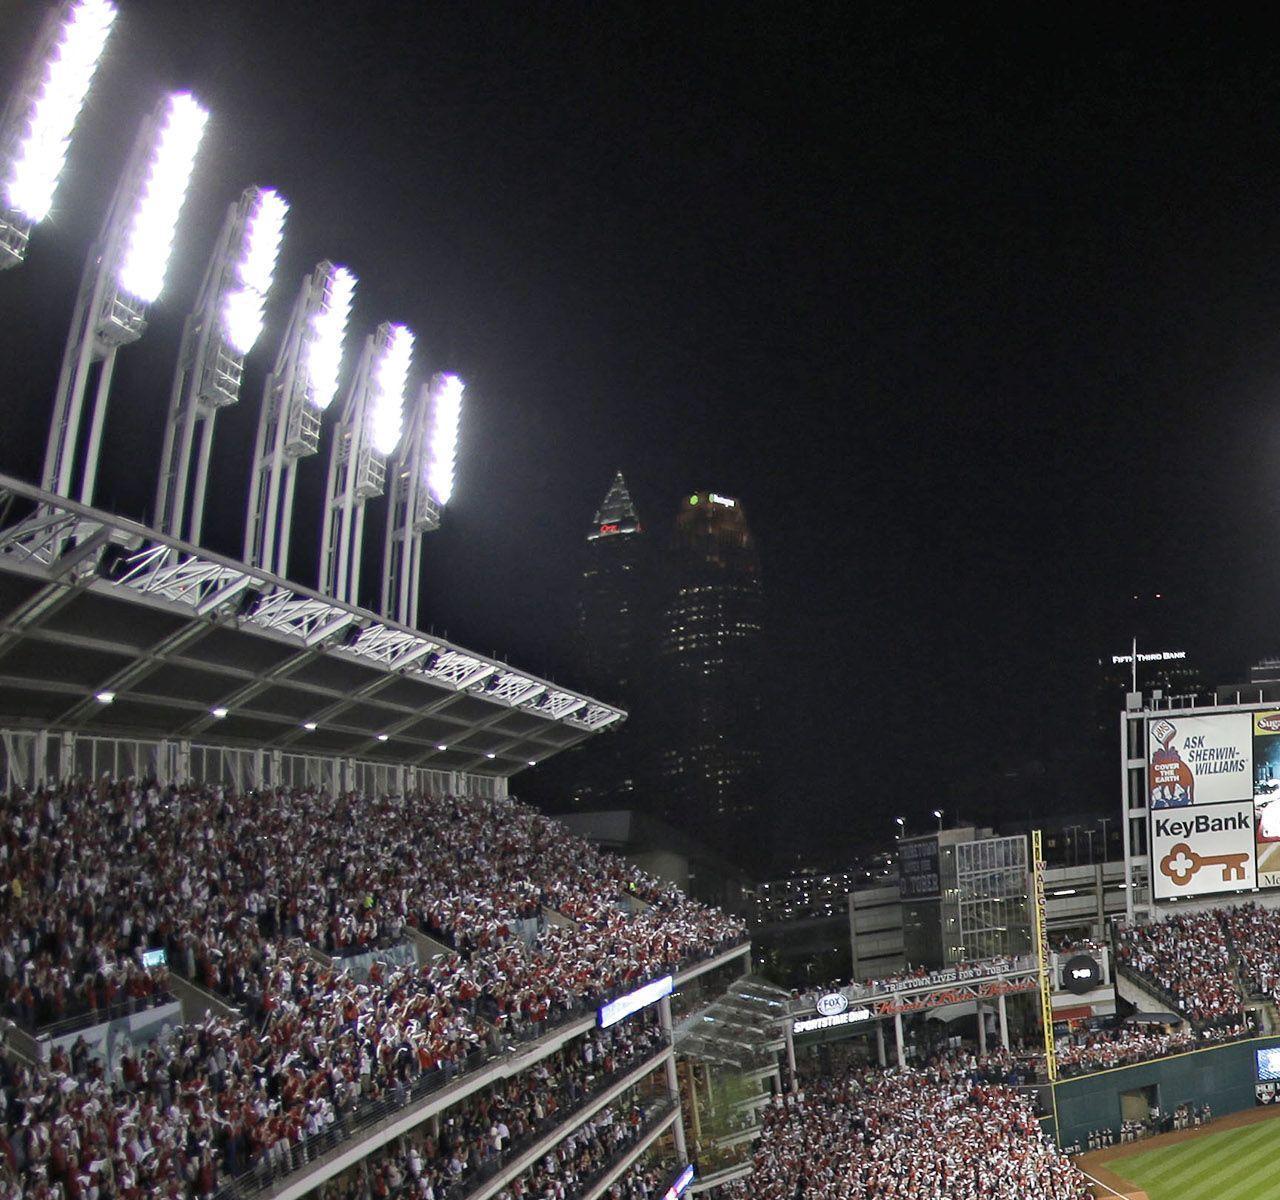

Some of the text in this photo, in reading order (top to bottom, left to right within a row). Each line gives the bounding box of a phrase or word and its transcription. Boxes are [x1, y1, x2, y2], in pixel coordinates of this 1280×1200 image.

[1163, 652, 1186, 660] BANK
[1183, 736, 1205, 750] ASK
[1188, 747, 1240, 763] SHERWIN-
[1154, 763, 1180, 771] COVER
[1195, 759, 1245, 776] WILLIAMS
[1155, 775, 1180, 783] EARTH
[1156, 812, 1250, 838] KeyBank
[1035, 861, 1048, 963] WALGREENS
[932, 973, 957, 984] LIVES
[823, 997, 840, 1008] FOX
